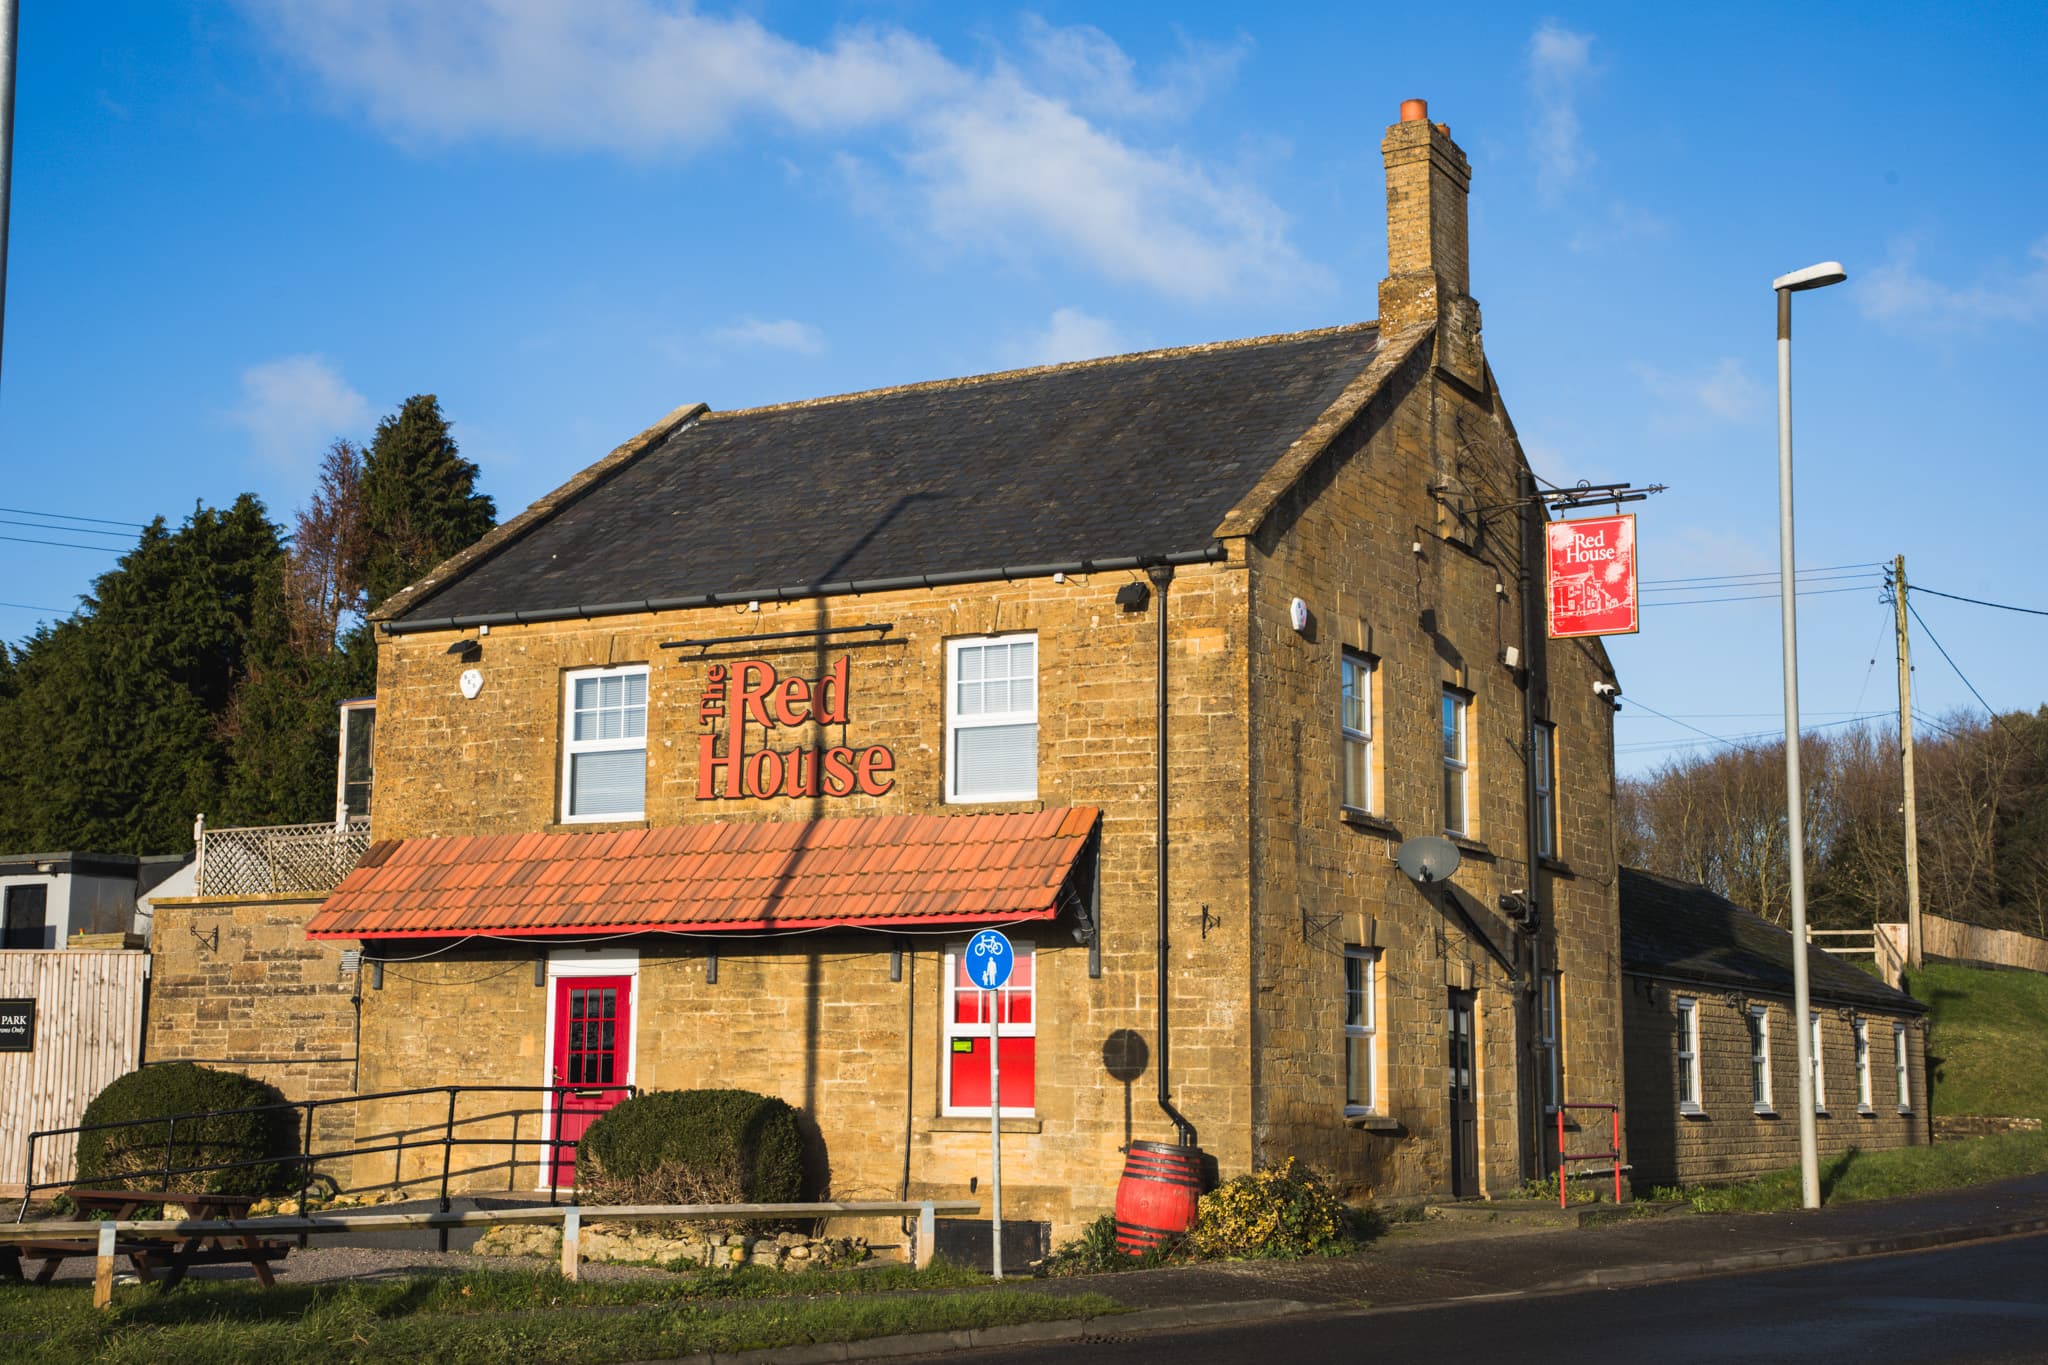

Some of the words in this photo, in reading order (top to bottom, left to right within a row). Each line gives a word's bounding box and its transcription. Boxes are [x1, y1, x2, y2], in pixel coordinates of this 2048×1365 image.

[1575, 530, 1605, 548] Red
[1566, 546, 1615, 563] House
[700, 664, 727, 725] The
[730, 654, 850, 728] Red
[695, 734, 895, 801] House
[1, 1015, 27, 1025] PARK
[11, 1026, 26, 1035] Only
